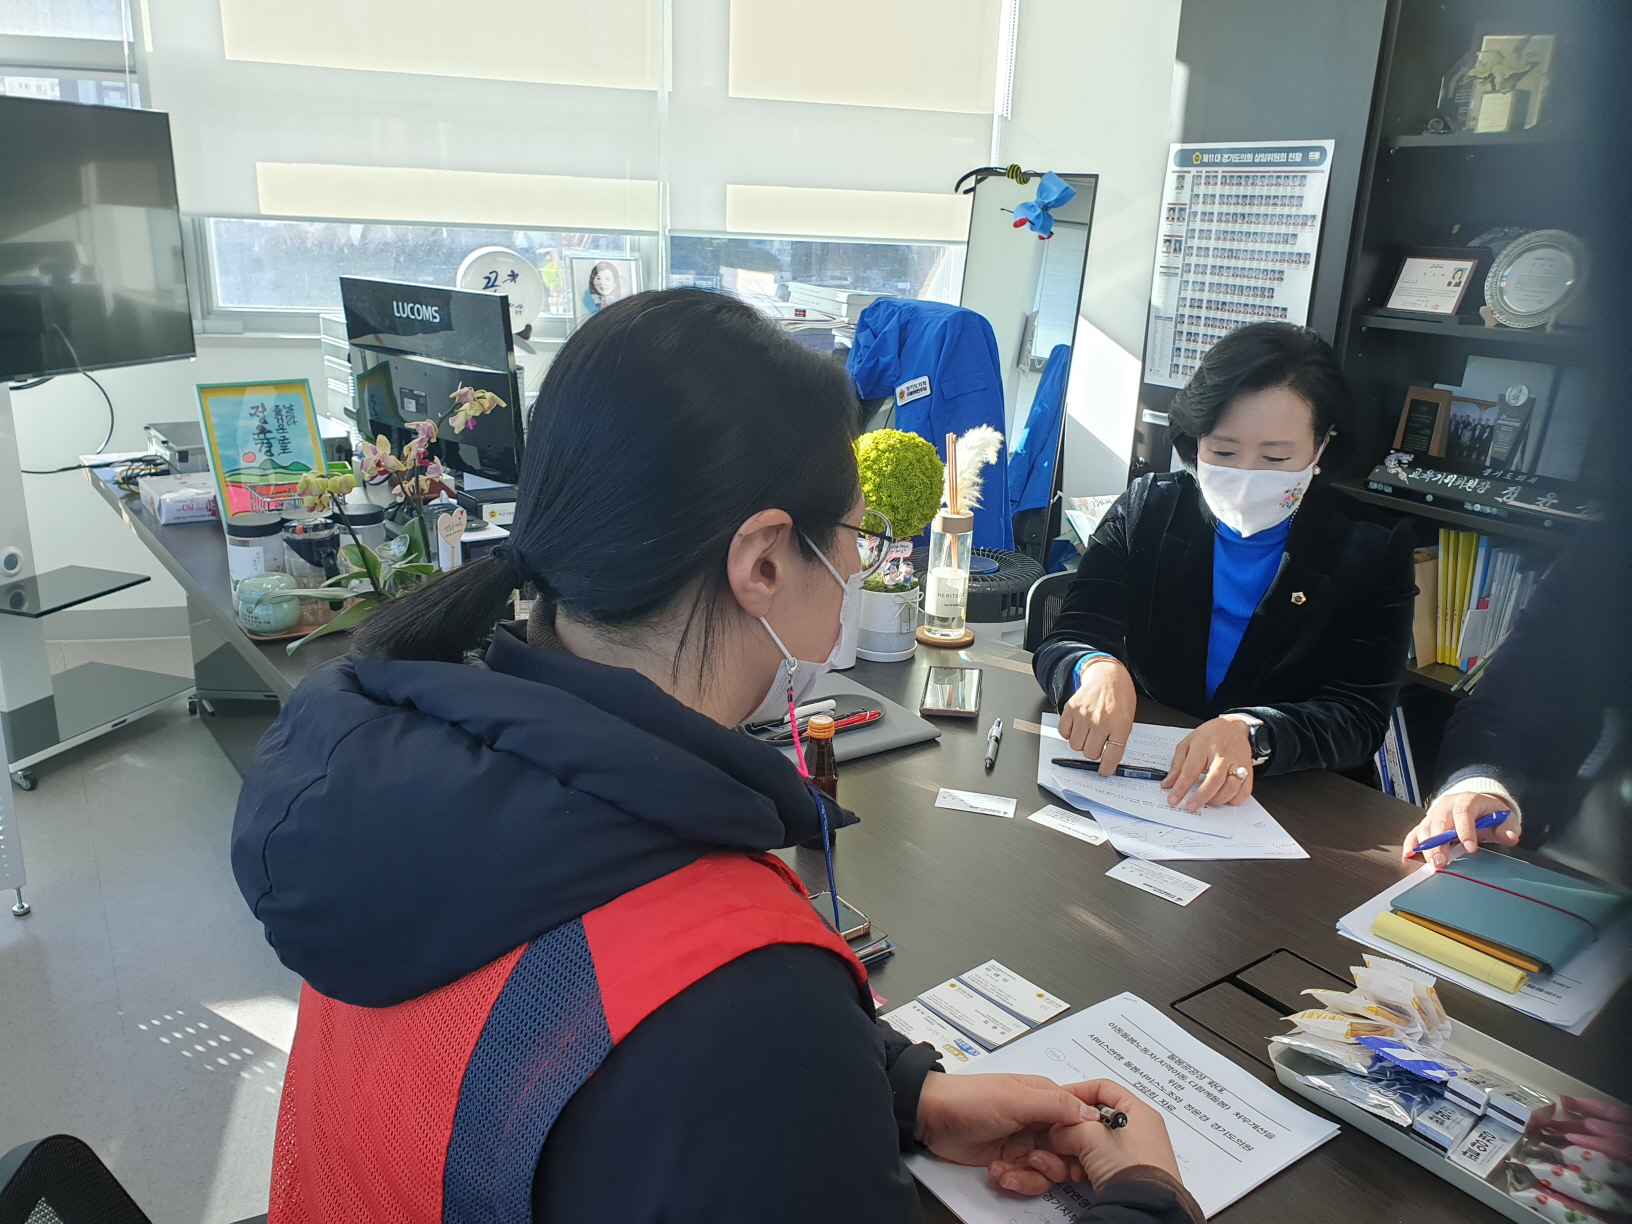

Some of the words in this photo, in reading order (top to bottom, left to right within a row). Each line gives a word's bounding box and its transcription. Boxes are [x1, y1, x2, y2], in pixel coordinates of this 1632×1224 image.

[1221, 152, 1253, 163] 경기도의회
[1254, 152, 1287, 162] 상임위원회
[1288, 152, 1302, 162] 현황
[393, 300, 440, 323] LUCOMS
[1167, 1053, 1207, 1081] 돌봄공공성
[1087, 1033, 1125, 1062] 서비스연맹
[1123, 1060, 1184, 1103] 돌봄서비스노조와
[1210, 1121, 1254, 1152] 경기도의원
[1133, 1080, 1159, 1101] 간담회
[1160, 1098, 1177, 1112] 자료
[1167, 1078, 1185, 1092] 위한
[1232, 1110, 1276, 1140] 처우개선을
